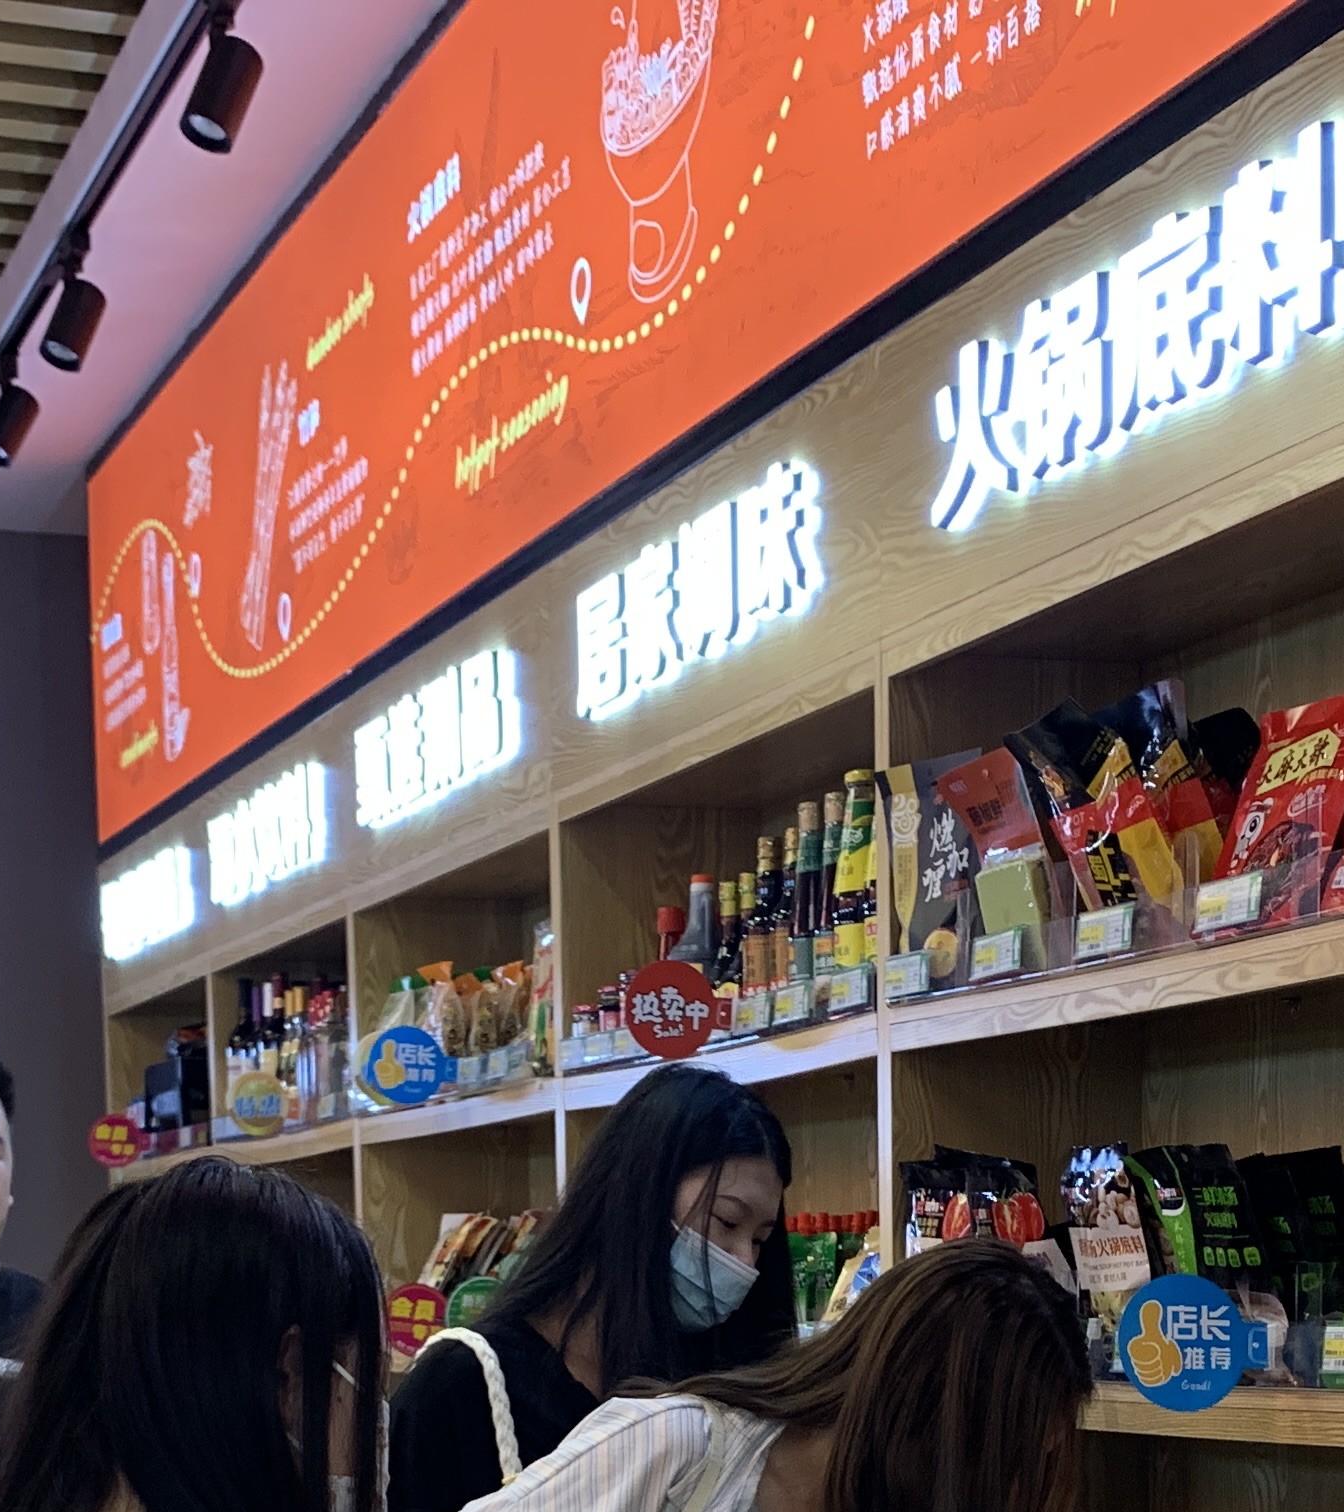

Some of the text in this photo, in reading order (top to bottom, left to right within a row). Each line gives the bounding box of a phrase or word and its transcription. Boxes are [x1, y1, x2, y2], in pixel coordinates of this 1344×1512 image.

[630, 984, 710, 1031] 热卖中
[397, 1043, 438, 1067] 店长
[391, 1296, 436, 1323] 会员
[1165, 1304, 1232, 1342] 店长
[1183, 1346, 1232, 1371] 推荐
